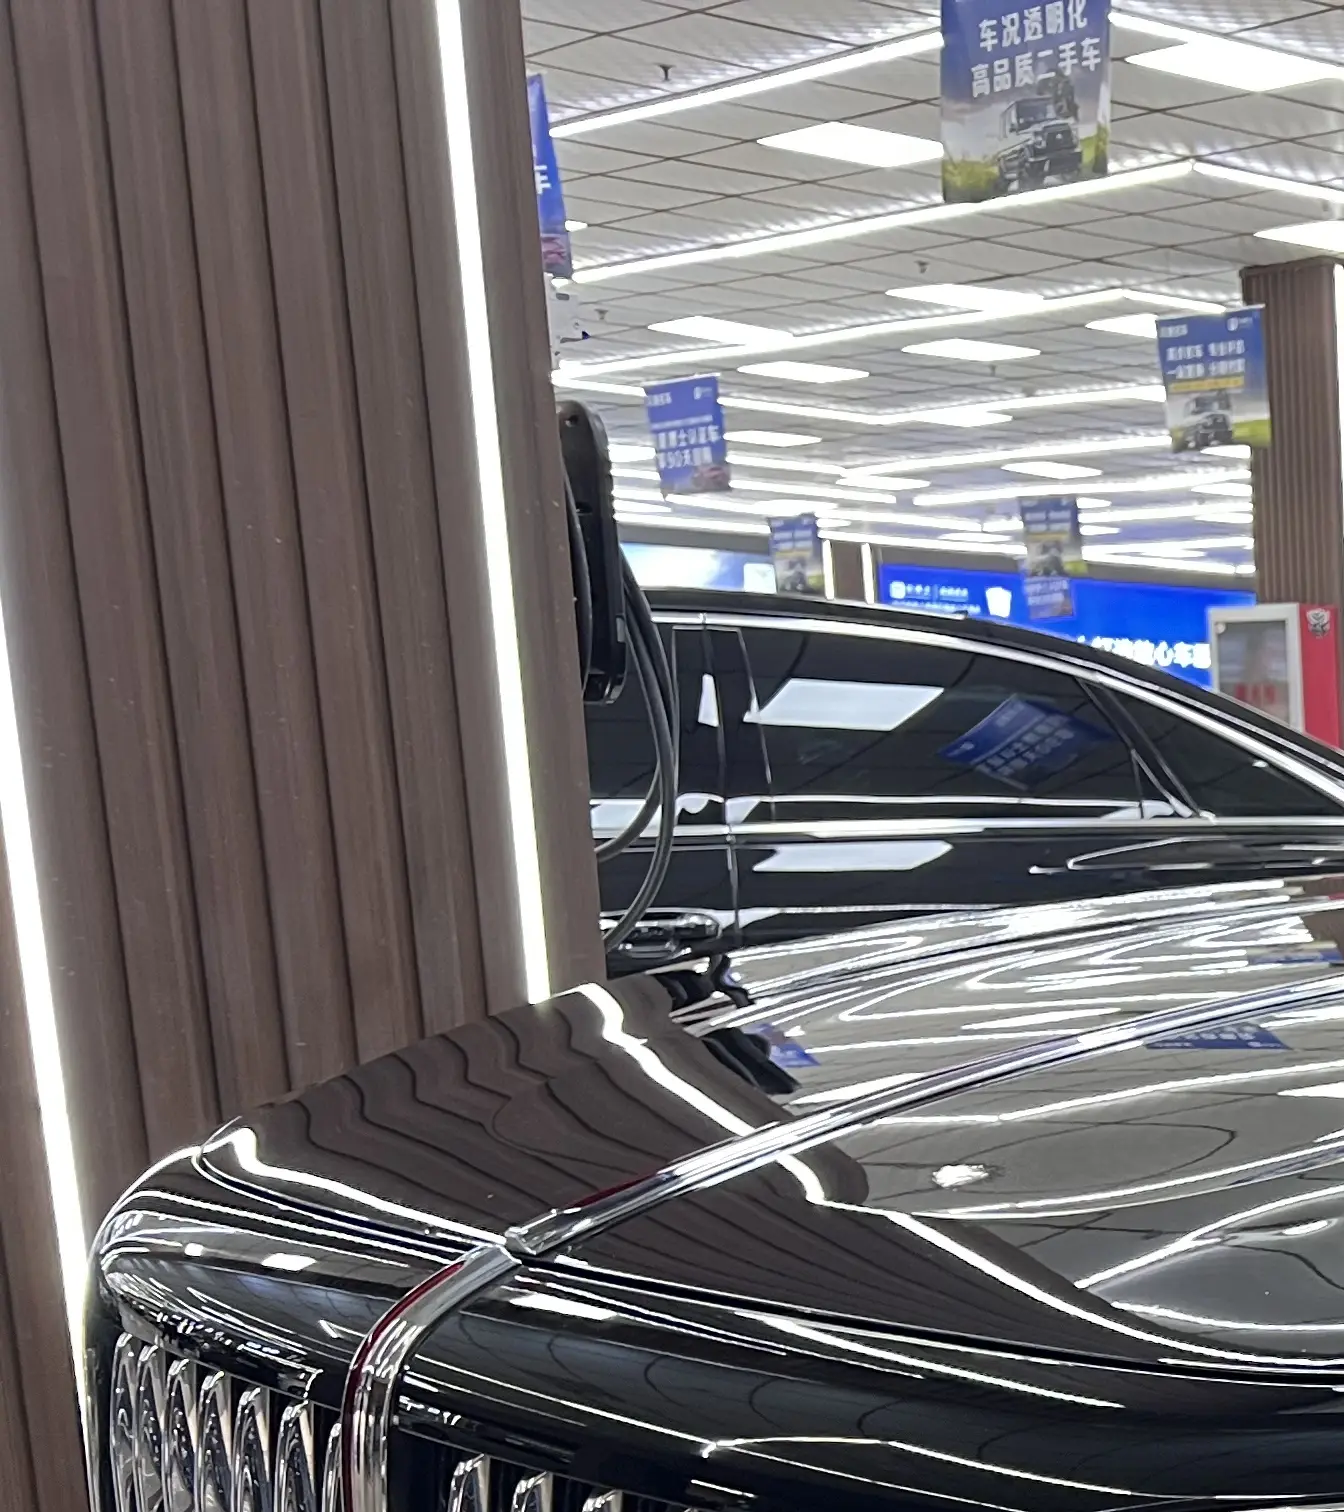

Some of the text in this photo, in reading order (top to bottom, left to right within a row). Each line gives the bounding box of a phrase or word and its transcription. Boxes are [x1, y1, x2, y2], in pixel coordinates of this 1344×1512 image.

[978, 0, 1088, 52] 车况透明化
[971, 37, 1101, 98] 高品质二手车
